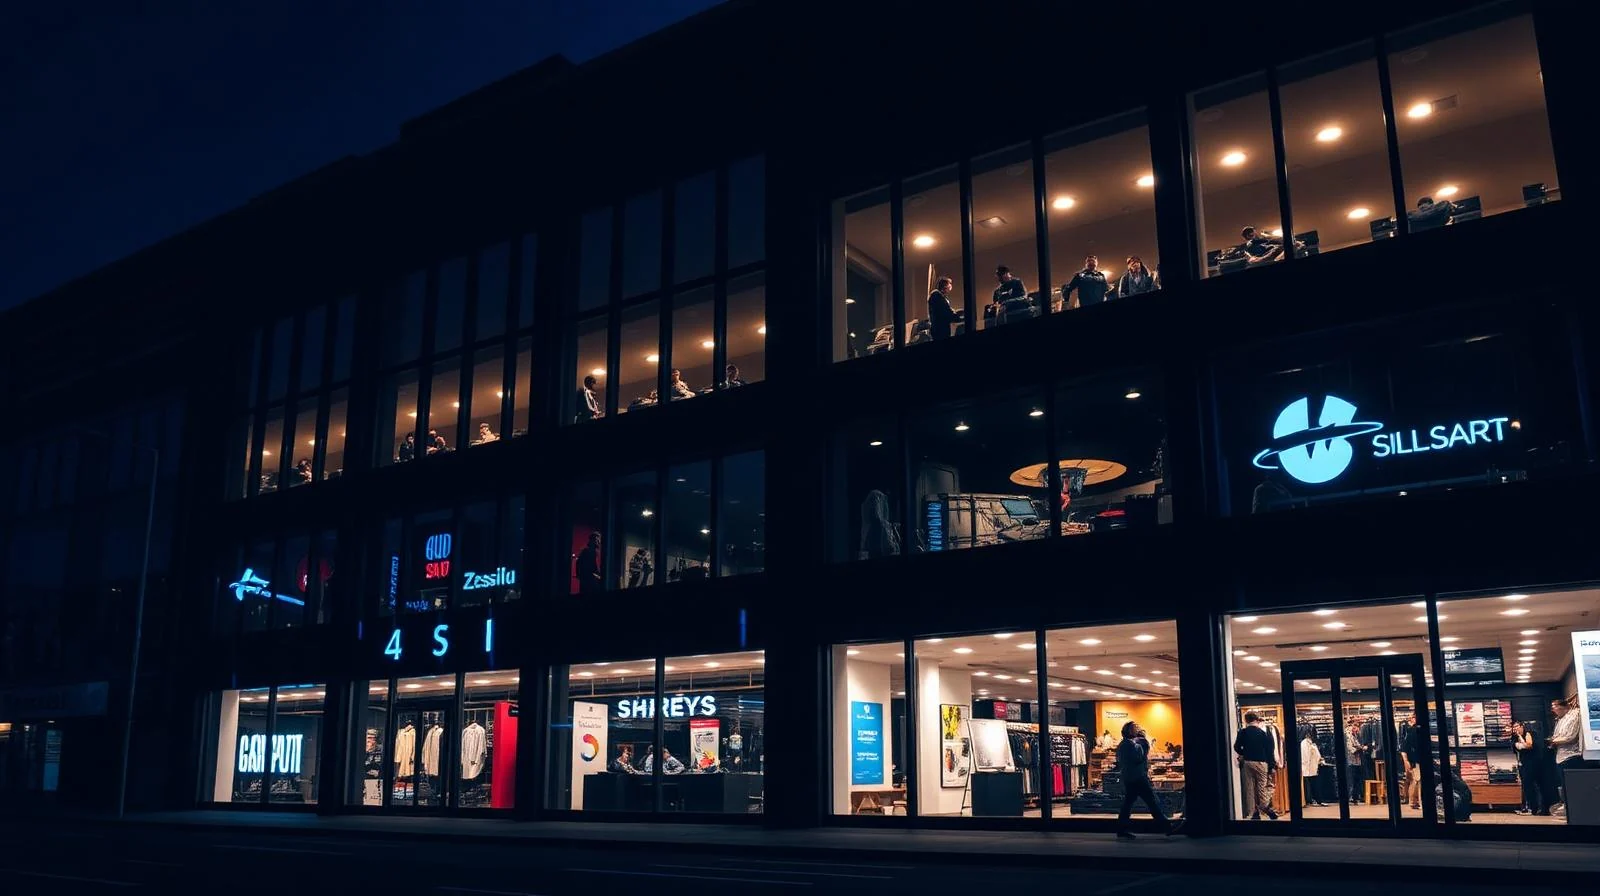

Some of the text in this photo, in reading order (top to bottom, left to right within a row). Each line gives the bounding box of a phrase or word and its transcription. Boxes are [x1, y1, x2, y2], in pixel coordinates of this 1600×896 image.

[1372, 417, 1508, 457] SILLSART
[385, 629, 402, 660] 4
[432, 625, 448, 657] S
